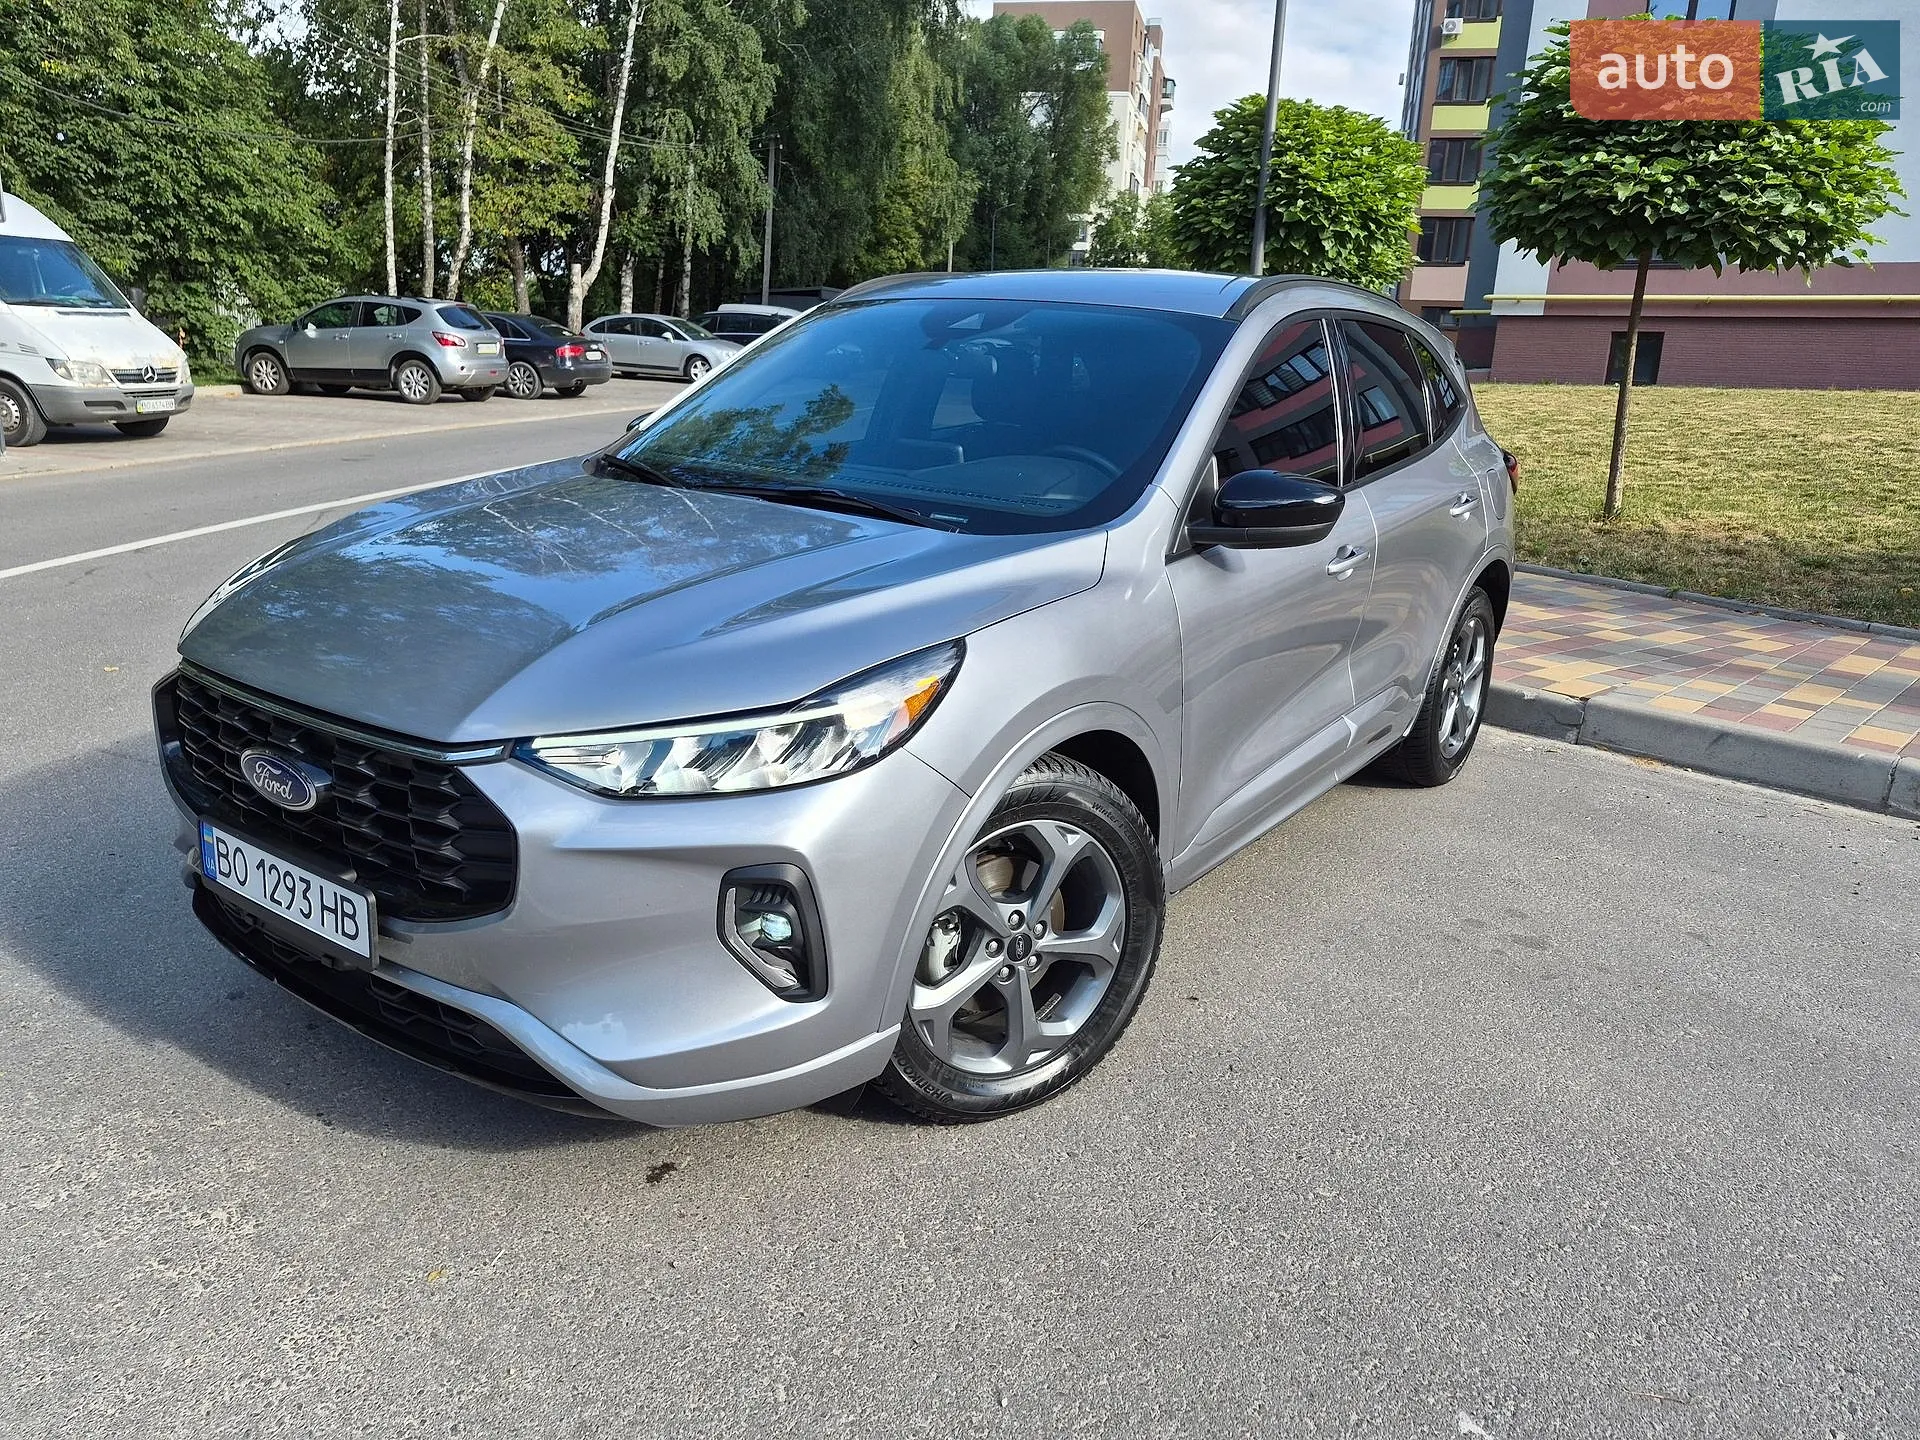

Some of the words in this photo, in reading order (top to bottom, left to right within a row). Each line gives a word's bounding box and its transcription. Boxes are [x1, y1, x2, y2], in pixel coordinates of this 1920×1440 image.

[253, 761, 293, 800] Ford
[205, 856, 215, 870] UA
[216, 836, 248, 886] BO
[256, 859, 312, 919] 1293
[319, 885, 360, 941] HB
